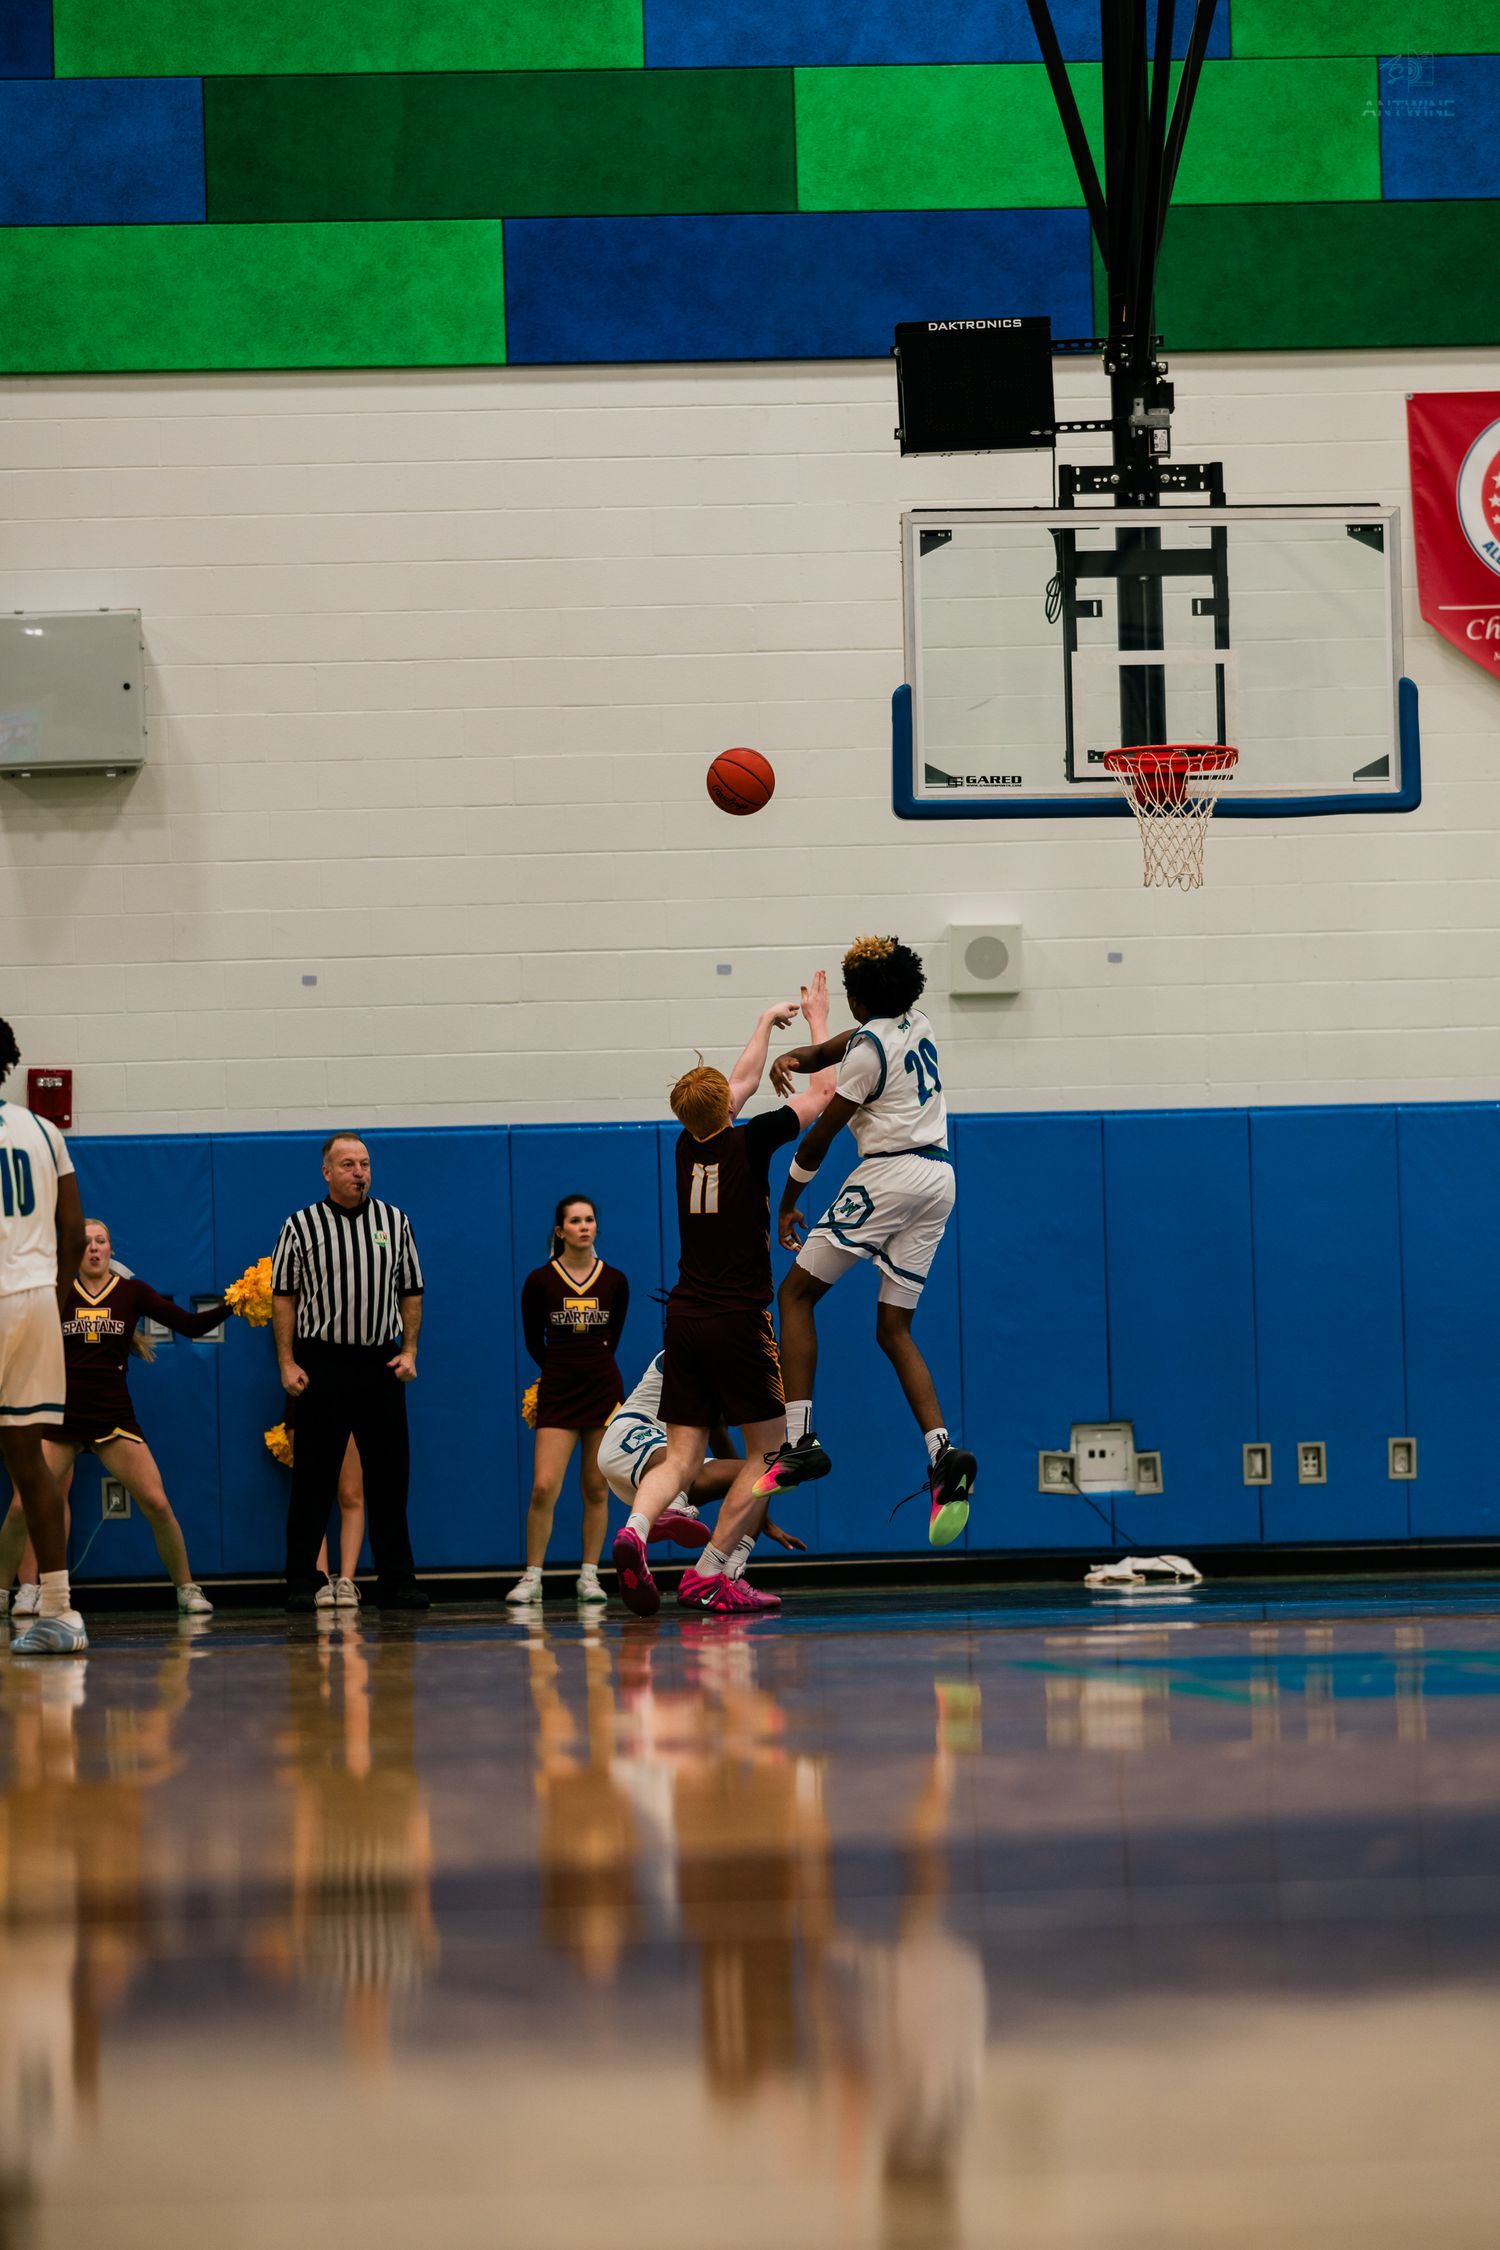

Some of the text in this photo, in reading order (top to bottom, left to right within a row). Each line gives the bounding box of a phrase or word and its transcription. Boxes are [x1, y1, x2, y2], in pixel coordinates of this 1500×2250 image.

[927, 318, 1022, 331] DAKTRONICS
[965, 775, 1022, 784] GARED
[0, 1147, 36, 1217] 10
[689, 1162, 720, 1214] 11
[550, 1309, 610, 1326] SPARTANS
[62, 1319, 125, 1337] SPARTANS
